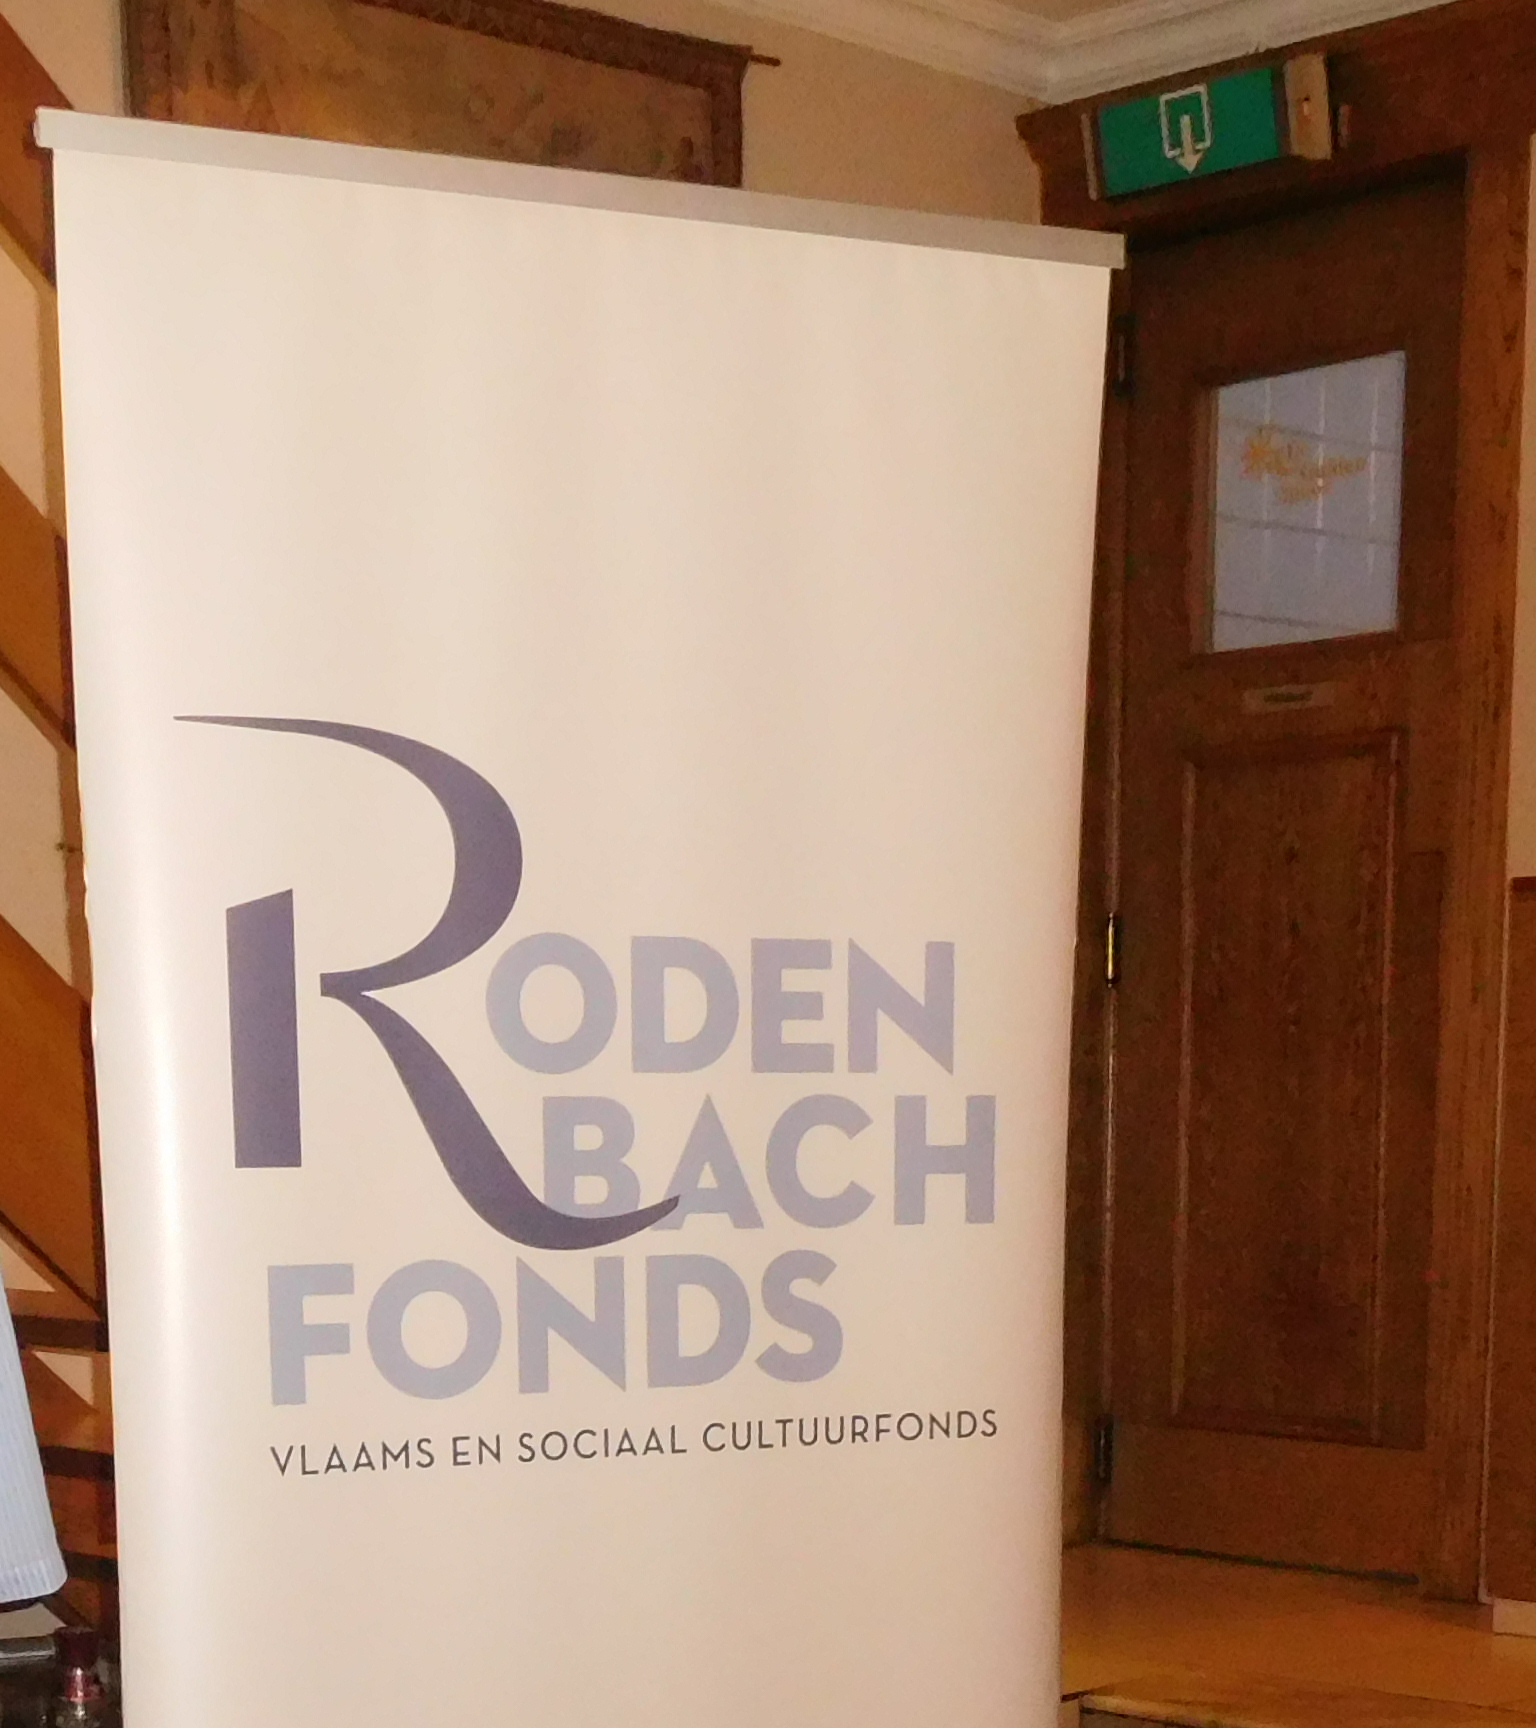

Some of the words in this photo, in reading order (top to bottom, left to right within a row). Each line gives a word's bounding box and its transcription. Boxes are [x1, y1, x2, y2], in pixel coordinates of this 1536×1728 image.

[541, 1093, 998, 1233] BACH
[266, 1249, 846, 1406] FONDS
[269, 1438, 436, 1478] VLAAMS
[452, 1434, 502, 1467] EN
[517, 1425, 688, 1464] SOCIAAL
[702, 1408, 1000, 1453] CULTUURFONDS
